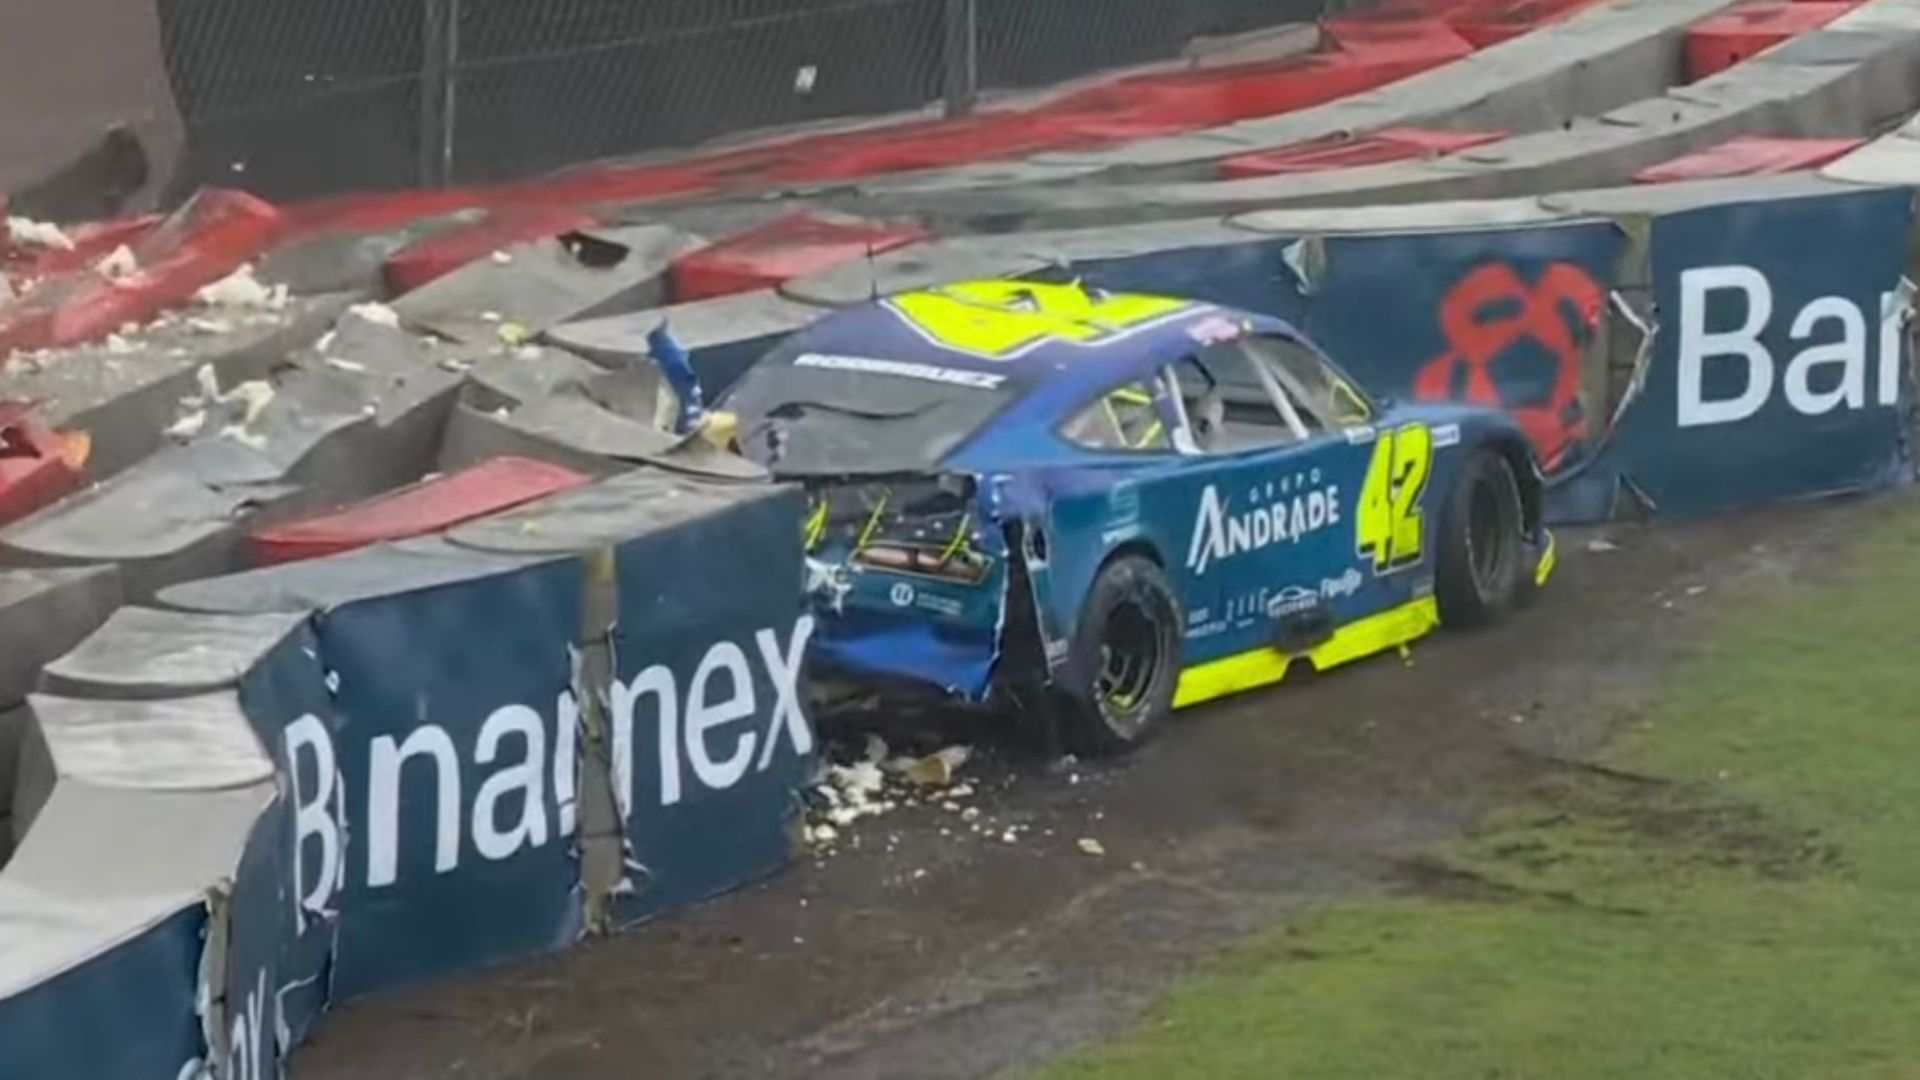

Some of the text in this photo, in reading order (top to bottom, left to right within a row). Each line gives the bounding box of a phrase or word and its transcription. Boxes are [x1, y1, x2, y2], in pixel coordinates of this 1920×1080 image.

[1186, 484, 1341, 576] ANDRADE
[1355, 422, 1434, 577] 42
[284, 614, 815, 938] Bnamex
